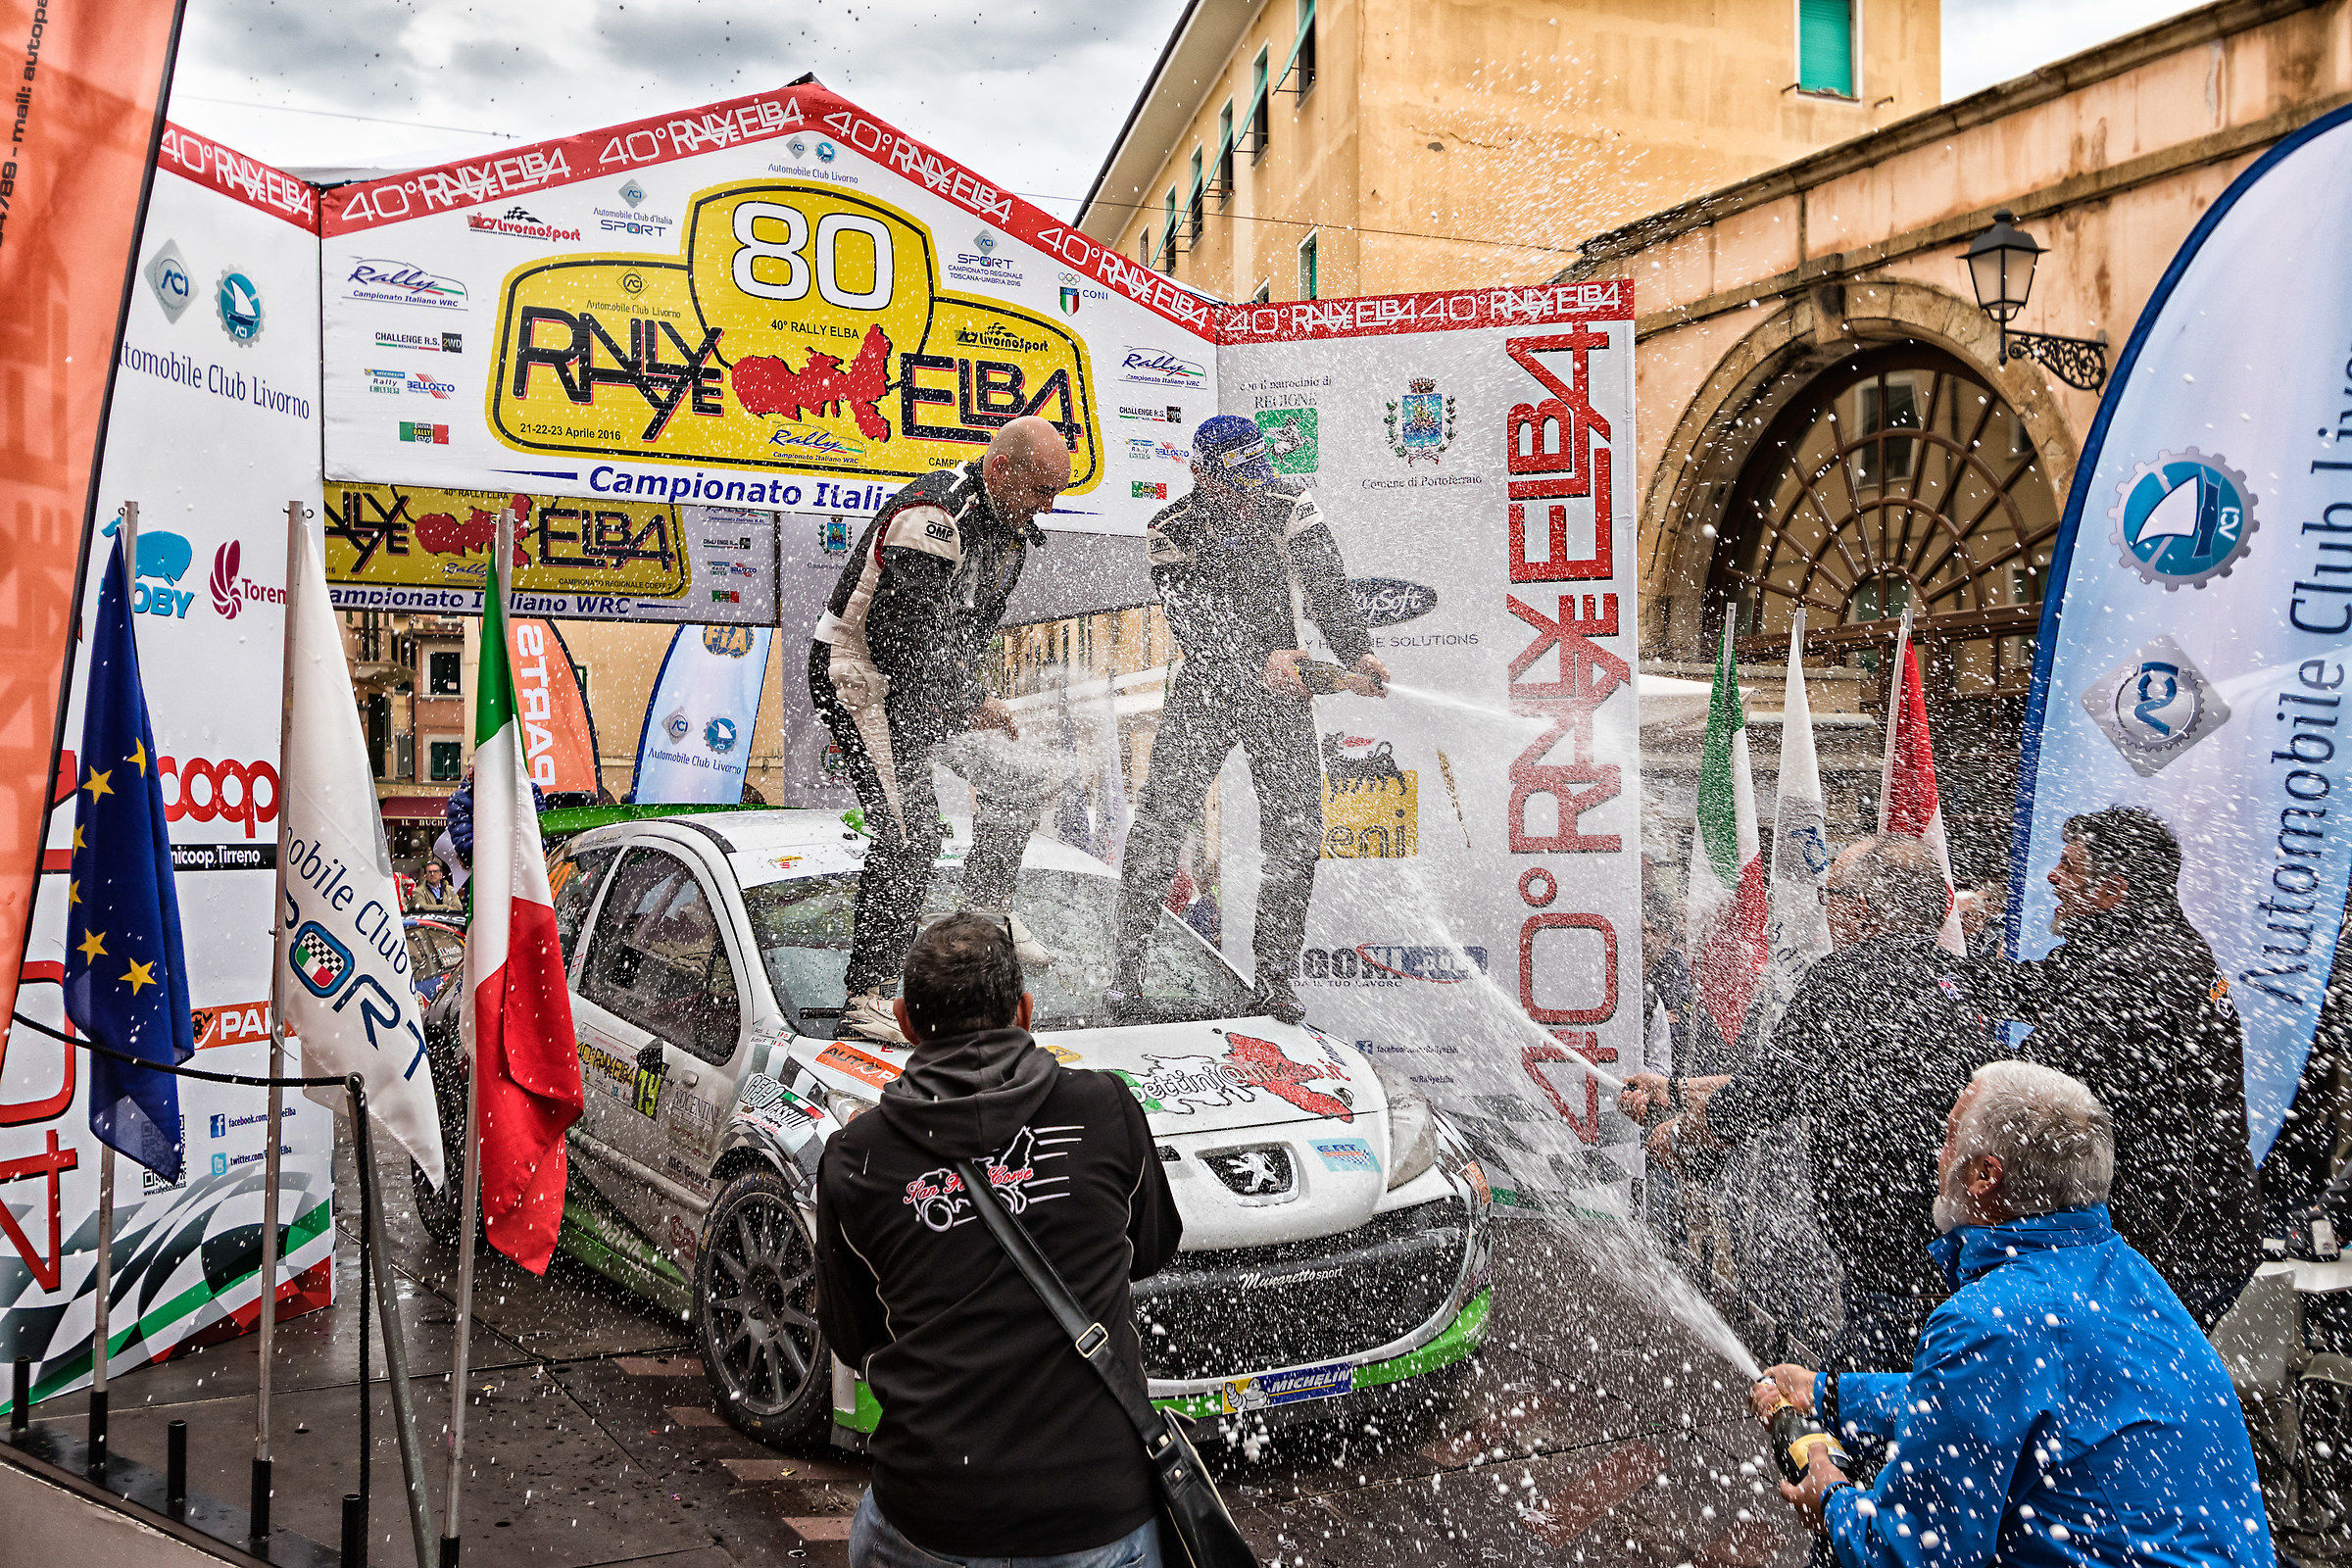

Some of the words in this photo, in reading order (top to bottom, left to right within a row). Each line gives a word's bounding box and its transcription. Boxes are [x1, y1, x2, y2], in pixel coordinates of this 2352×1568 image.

[13, 86, 32, 143] mail:
[24, 0, 49, 82] autop
[767, 163, 810, 177] Automobile
[812, 168, 829, 180] Club
[831, 171, 858, 184] Livorno
[593, 207, 632, 220] Automobile
[633, 212, 649, 221] Club
[601, 220, 666, 237] SPORT
[732, 200, 895, 312] 80
[957, 253, 1014, 270] SPORT
[348, 265, 442, 294] Rally
[948, 264, 988, 278] CAMPIONATO
[353, 289, 403, 302] Campionato
[405, 294, 437, 306] Italiano
[438, 297, 459, 308] WRC
[1083, 289, 1108, 301] CONI
[586, 298, 631, 315] Automobile
[631, 303, 651, 316] Club
[651, 307, 682, 319] Livorno
[375, 332, 423, 345] CHALLENGE
[770, 318, 789, 333] 40°
[790, 319, 828, 336] RALLY
[829, 324, 860, 340] ELBA
[121, 341, 203, 389] tomobile
[208, 364, 247, 402] Club
[253, 375, 311, 419] Livorno
[372, 377, 398, 387] Rally
[519, 422, 564, 437] 21-22-23
[564, 423, 596, 440] Aprile
[597, 428, 622, 442] 2016
[772, 451, 813, 462] Campionato
[842, 456, 859, 466] WRC
[589, 466, 810, 508] Campionato
[812, 480, 900, 515] Itali
[1362, 478, 1404, 490] Comune
[1407, 476, 1418, 488] di
[1421, 474, 1483, 487] Portoferraio
[925, 523, 954, 540] OMP
[2289, 502, 2352, 634] Club
[133, 582, 195, 619] OBY
[329, 588, 465, 611] ampionato
[576, 596, 631, 614] WRC
[1390, 633, 1479, 648] SOLUTIONS
[648, 747, 690, 764] Automobile
[691, 756, 710, 768] Club
[711, 759, 742, 774] Livorno
[157, 755, 281, 839] coop
[1325, 808, 1406, 859] eni
[2238, 658, 2346, 1006] Automobile
[216, 845, 261, 864] Tirreno
[355, 899, 408, 976] Club
[1271, 1369, 1352, 1393] MICHELIN
